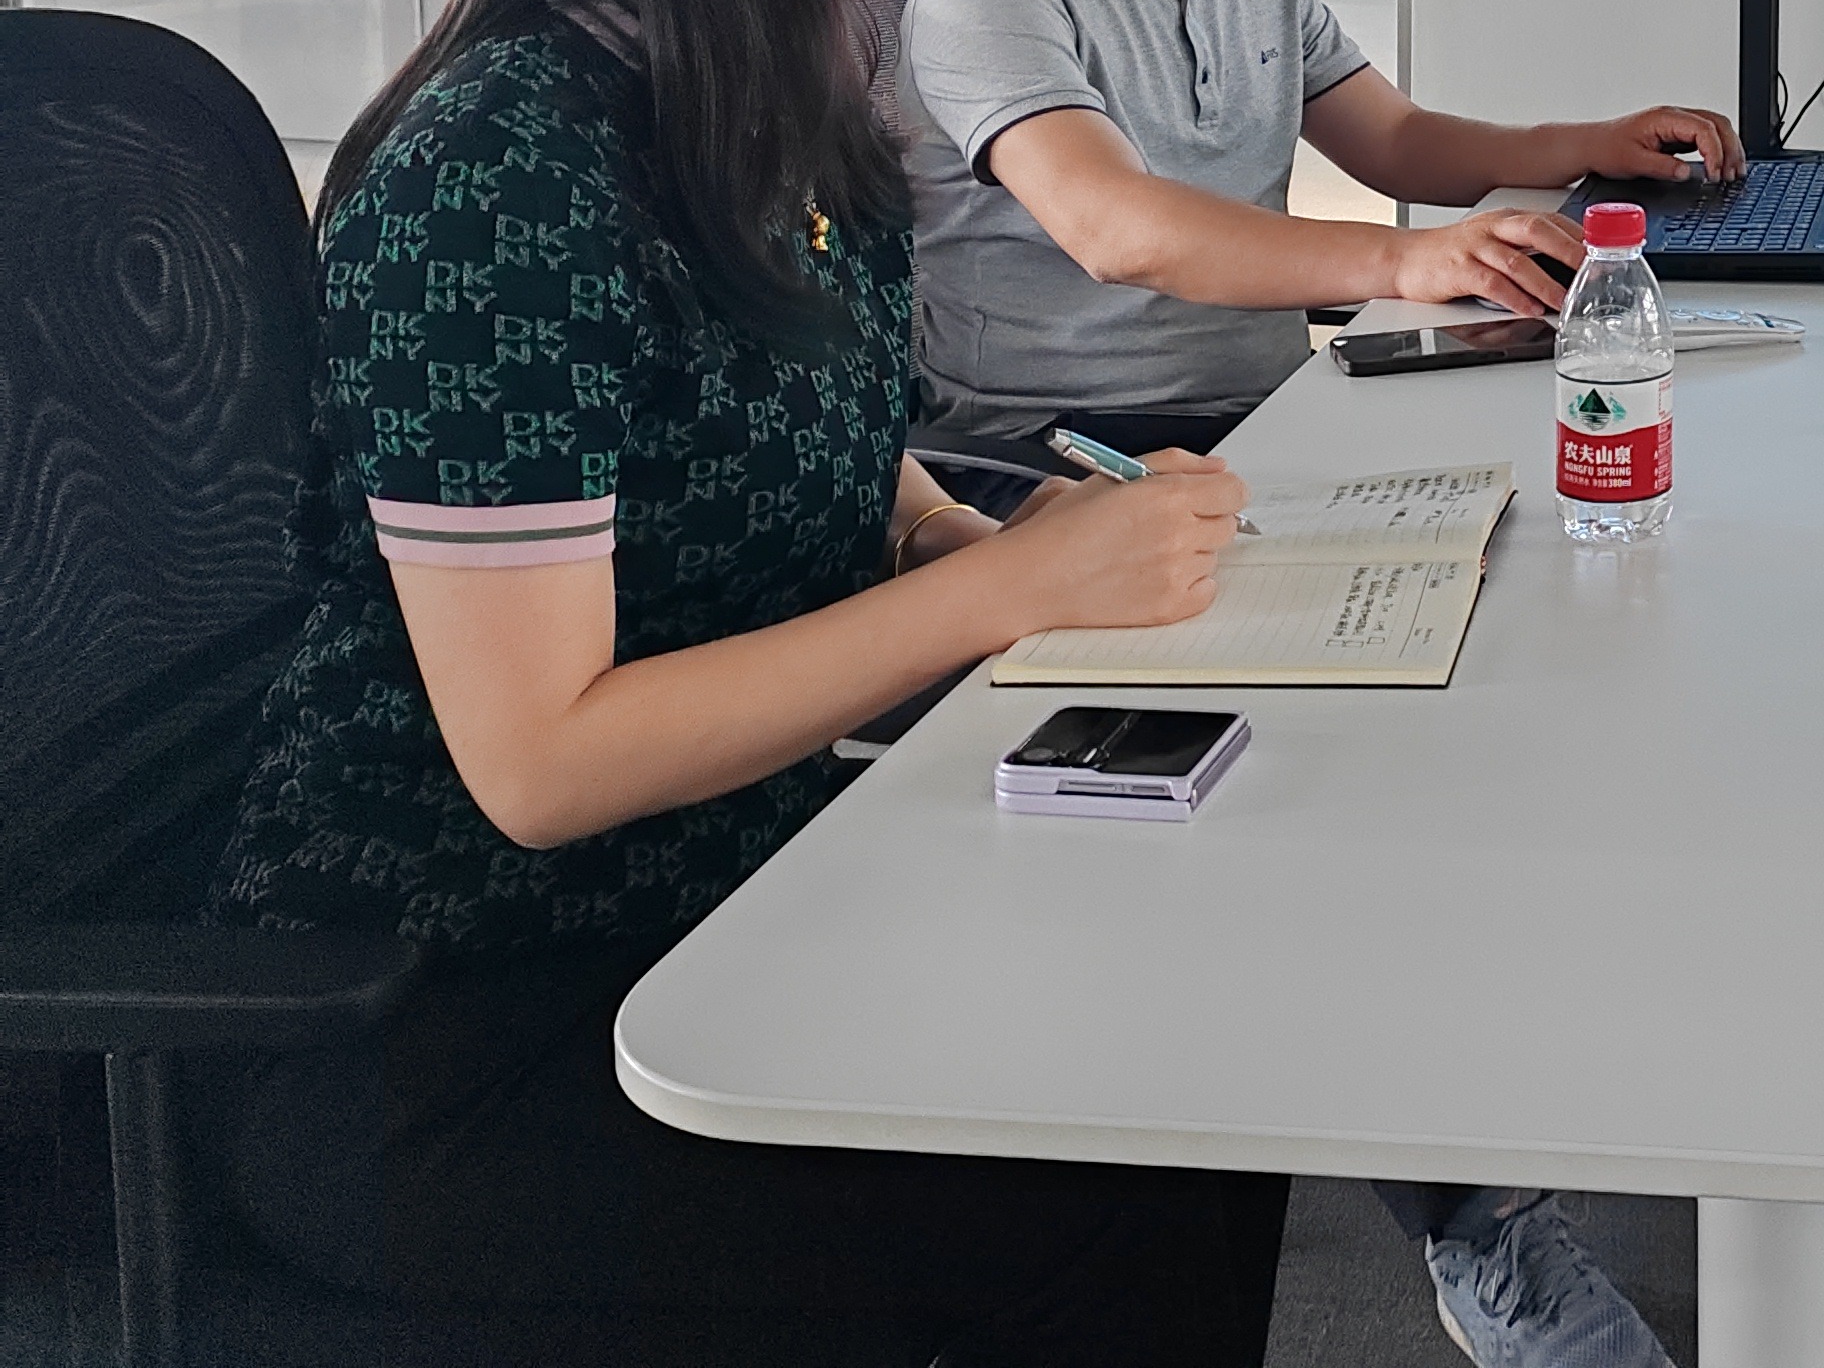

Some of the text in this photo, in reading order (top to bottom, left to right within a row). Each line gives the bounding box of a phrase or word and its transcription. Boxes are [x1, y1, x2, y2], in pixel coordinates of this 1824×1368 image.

[434, 160, 504, 186] DK
[432, 185, 500, 212] NY
[381, 211, 431, 238] DK
[495, 212, 569, 250] DK
[376, 237, 429, 263] NY
[494, 239, 576, 271] NY
[327, 260, 376, 285] DK
[426, 259, 494, 288] DK
[325, 285, 374, 310] NY
[425, 287, 498, 314] NY
[371, 309, 427, 337] DK
[495, 313, 566, 341] DK
[370, 336, 426, 361] NY
[495, 339, 568, 365] NY
[328, 357, 372, 382] DK
[427, 360, 500, 389] DK
[570, 361, 626, 388] DK
[428, 388, 501, 413] NY
[574, 385, 624, 410] NY
[372, 407, 433, 434] DK
[503, 410, 575, 437] DK
[375, 433, 435, 458] NY
[504, 432, 577, 460] NY
[1564, 440, 1633, 465] 农夫山泉
[437, 458, 513, 486] DK
[1596, 466, 1632, 477] SPRING
[857, 477, 882, 509] DK
